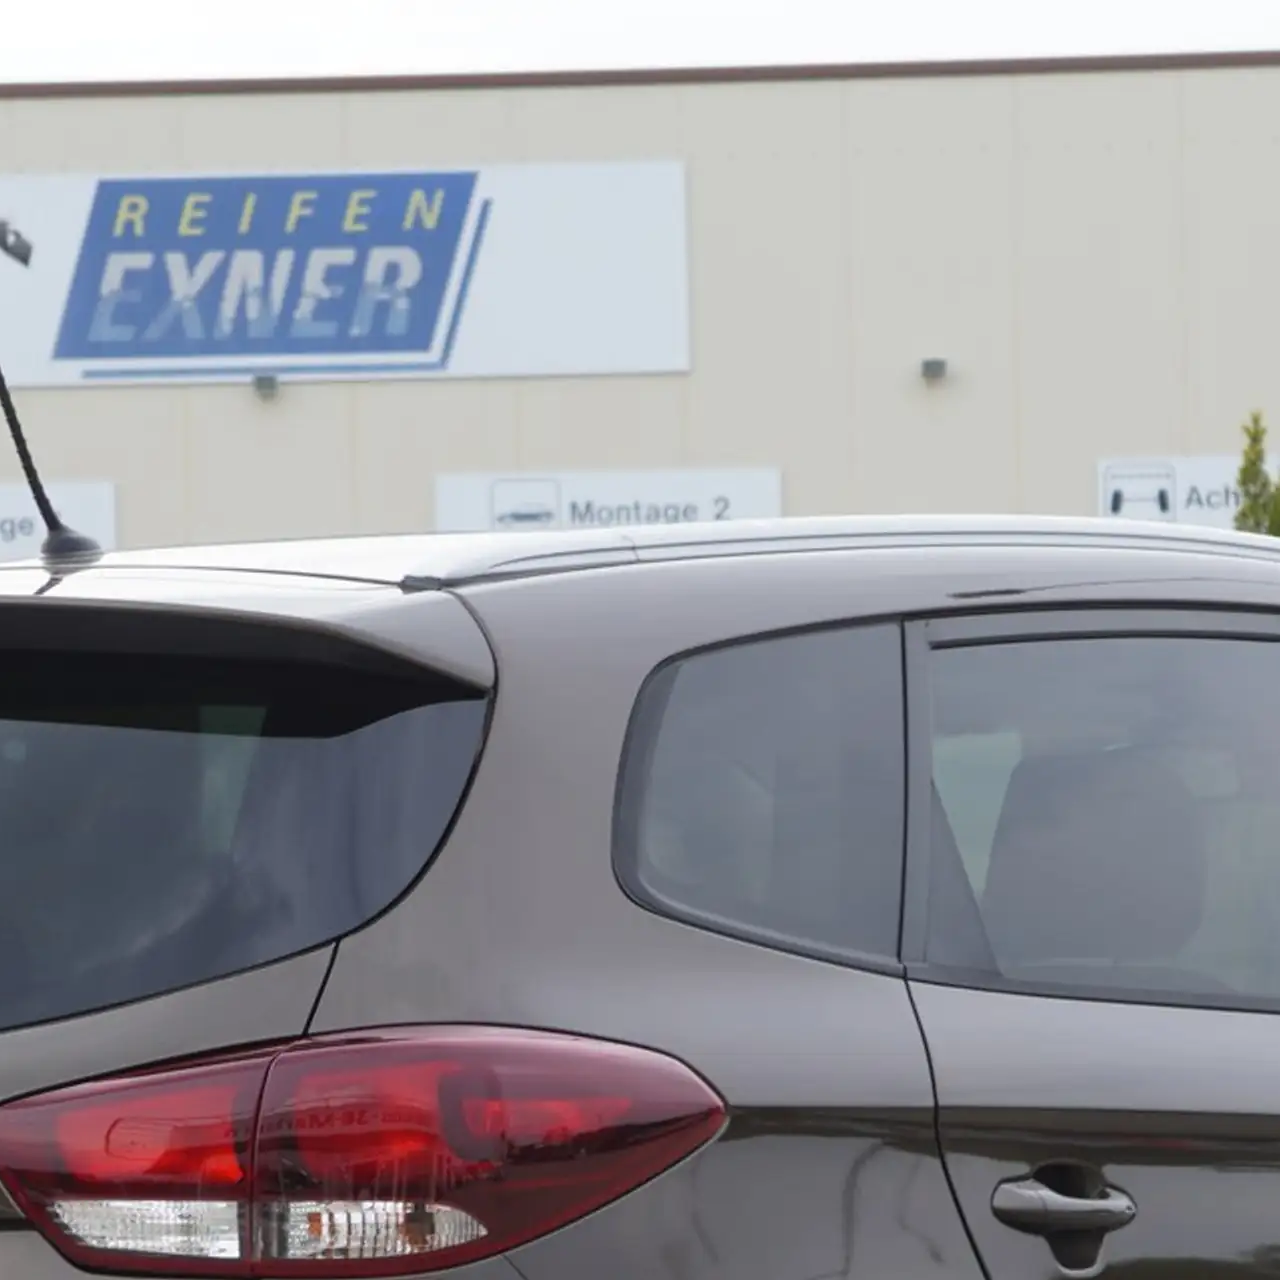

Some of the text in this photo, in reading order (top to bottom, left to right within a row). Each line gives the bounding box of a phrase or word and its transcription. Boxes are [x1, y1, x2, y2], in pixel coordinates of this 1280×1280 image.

[112, 189, 445, 237] REIFEN
[86, 245, 423, 342] EXNER
[570, 496, 731, 526] Montage 2
[1184, 484, 1241, 510] Ach
